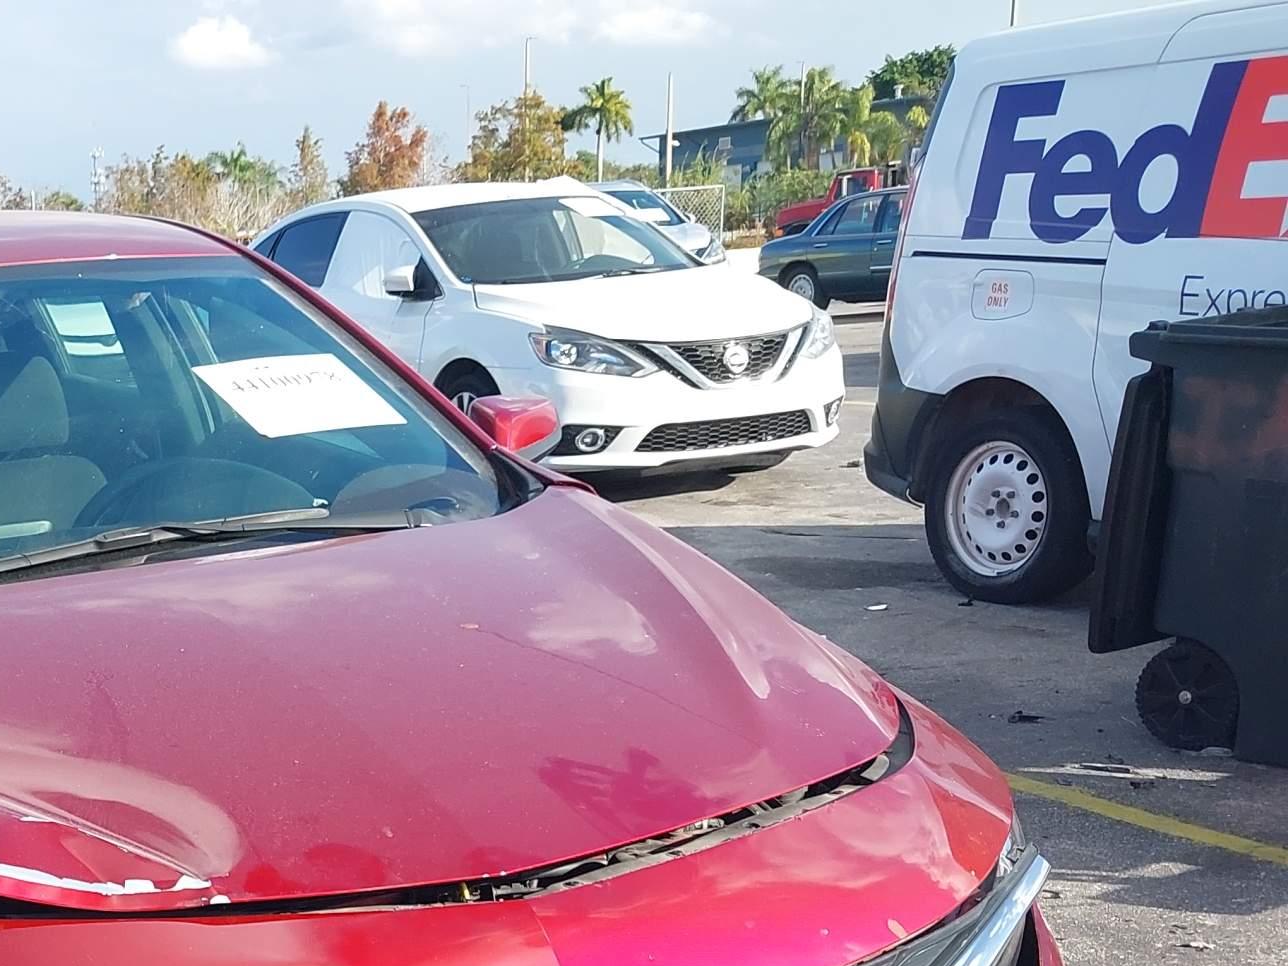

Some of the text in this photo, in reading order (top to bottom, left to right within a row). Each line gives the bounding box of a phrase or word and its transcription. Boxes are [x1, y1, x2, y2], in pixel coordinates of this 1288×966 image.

[960, 55, 1288, 245] FedE
[986, 295, 1009, 308] ONLY
[991, 282, 1009, 295] GAS
[1178, 274, 1288, 318] Expre
